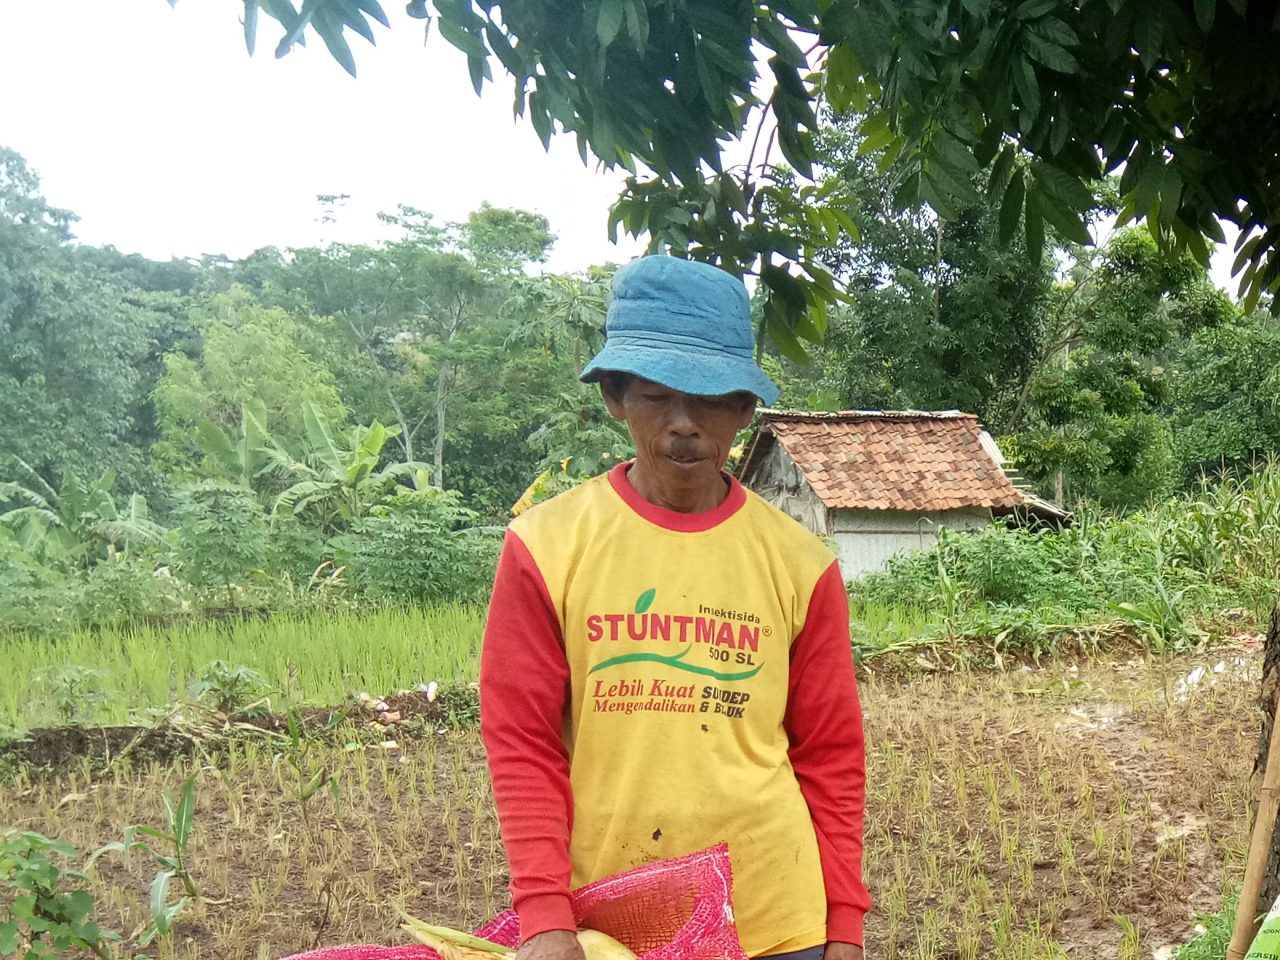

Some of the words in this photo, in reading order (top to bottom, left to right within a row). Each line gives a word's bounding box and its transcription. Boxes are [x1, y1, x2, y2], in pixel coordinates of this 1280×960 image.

[699, 604, 760, 624] Insektisida
[709, 646, 730, 662] 500
[735, 652, 755, 666] SL
[592, 679, 644, 698] Lebih
[648, 678, 696, 698] Kuat
[592, 698, 696, 715] Mengendalikan
[699, 701, 709, 712] &
